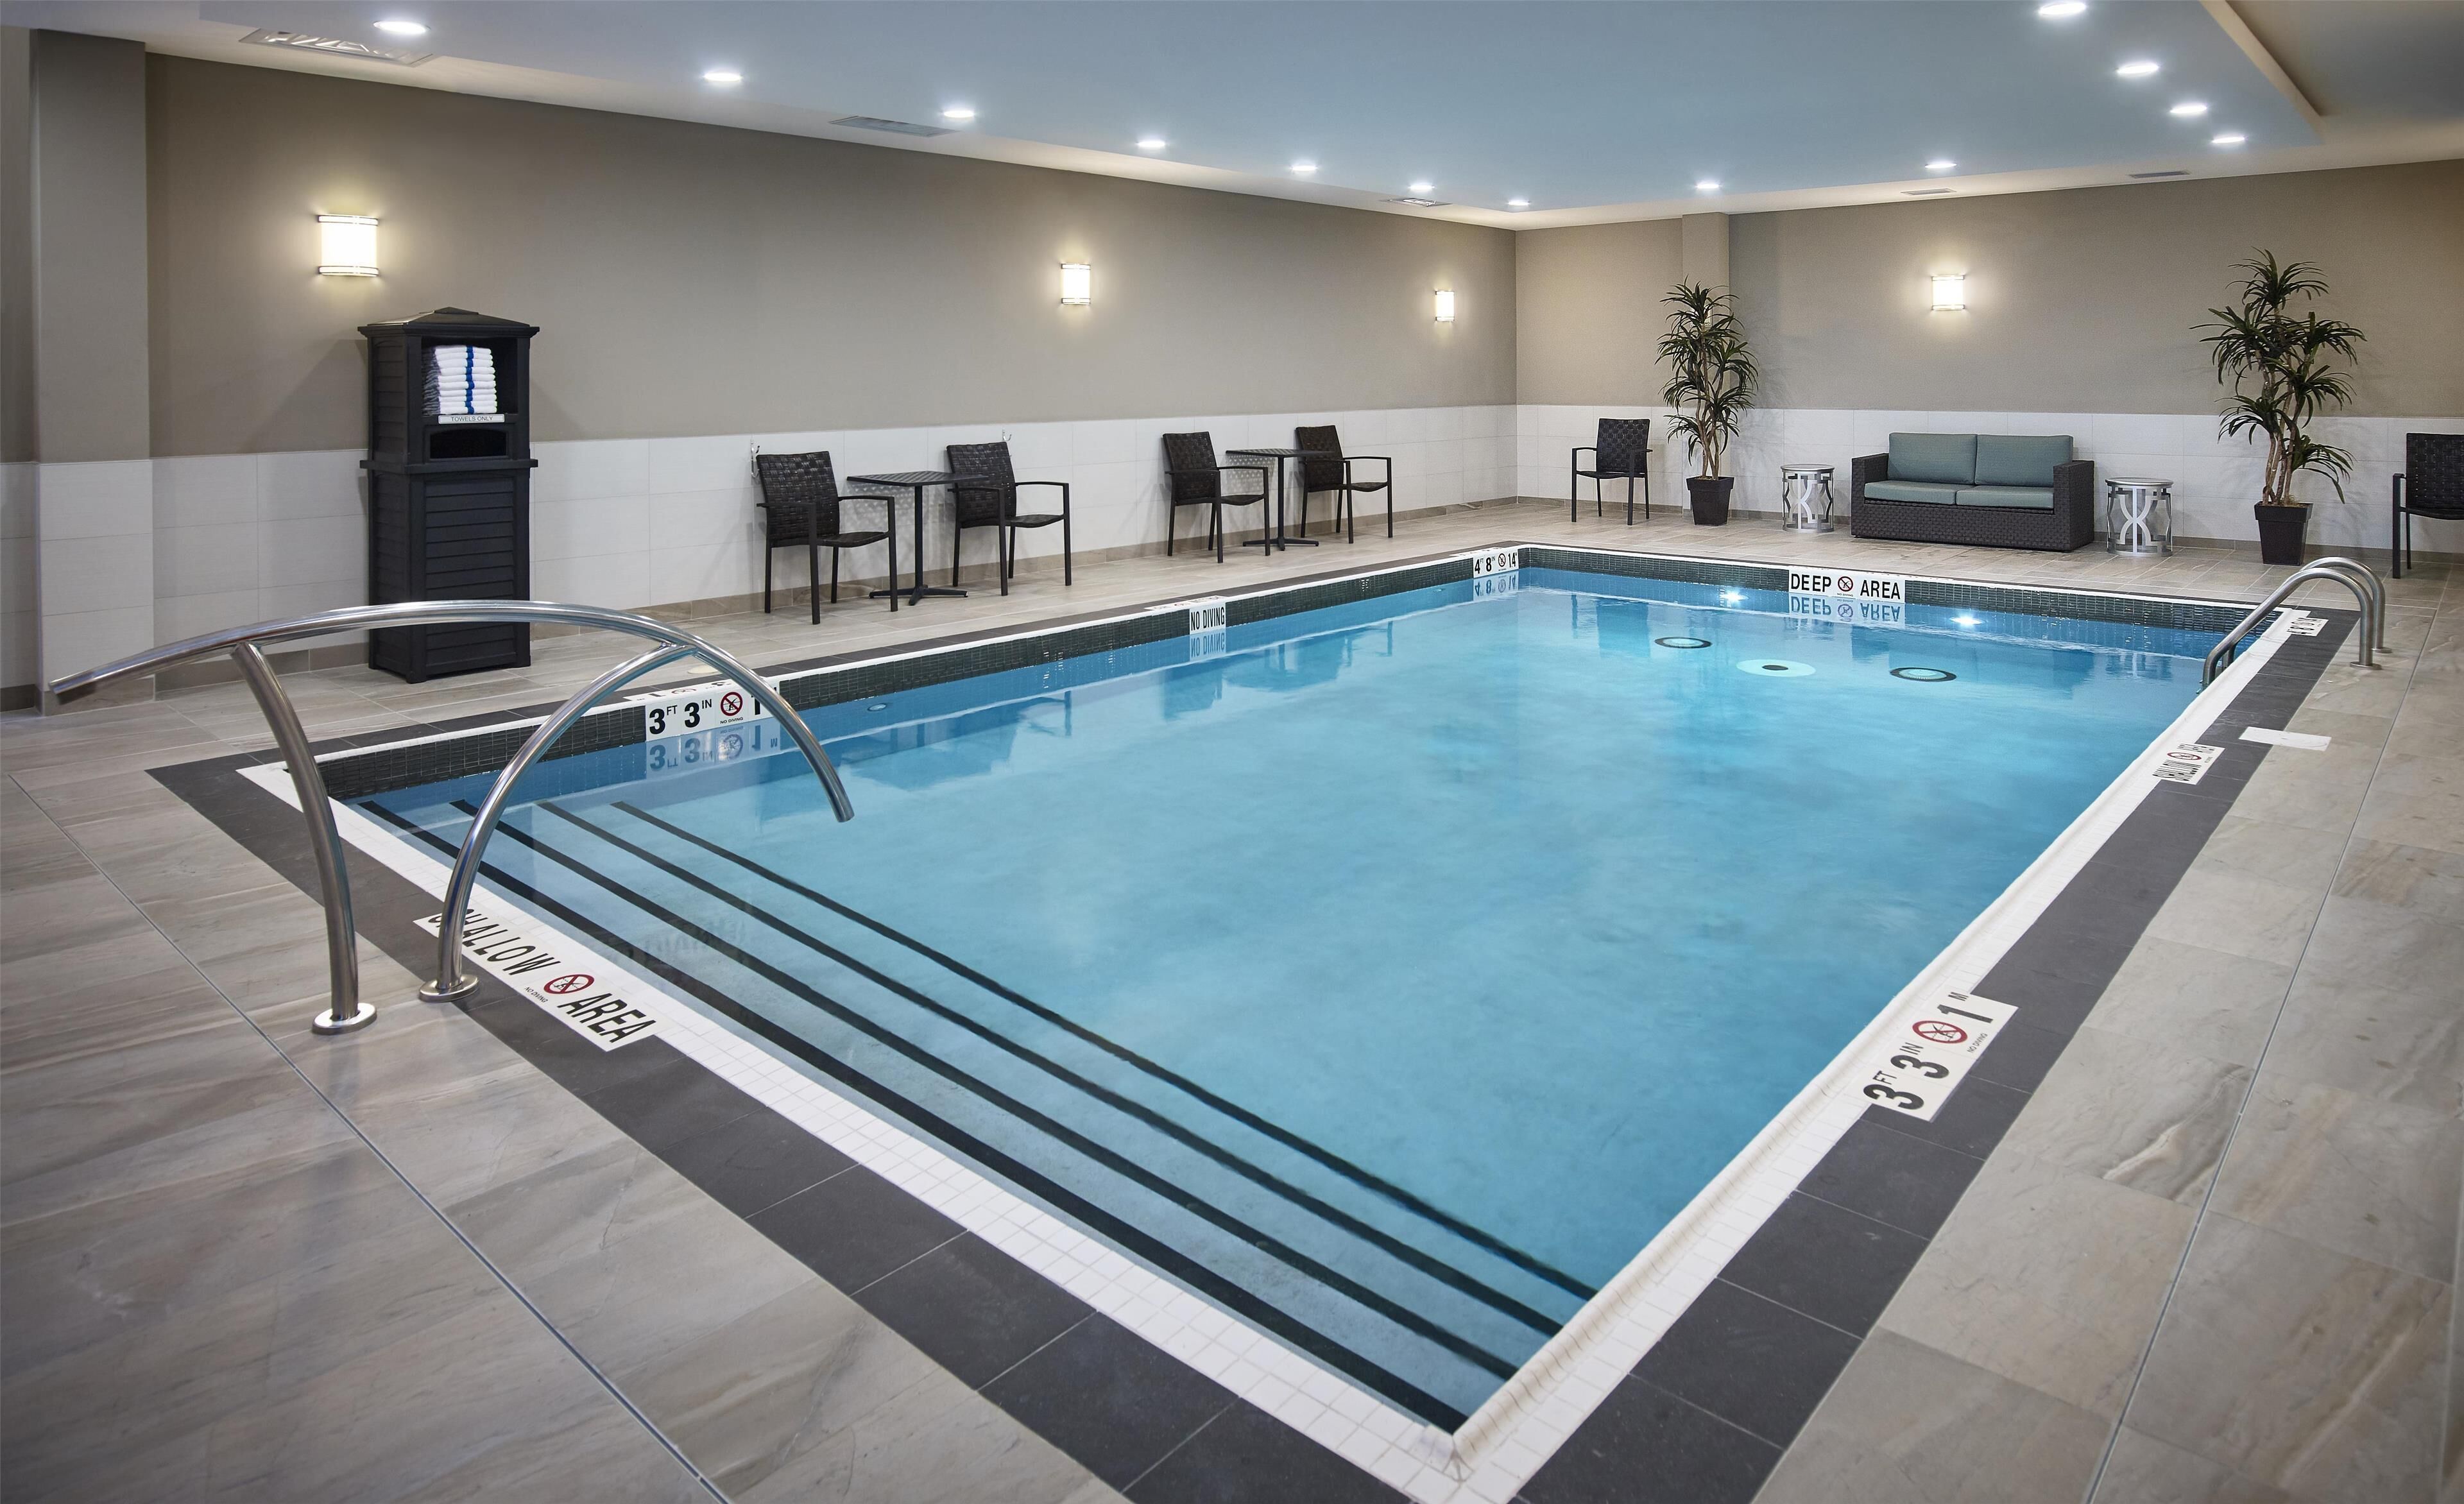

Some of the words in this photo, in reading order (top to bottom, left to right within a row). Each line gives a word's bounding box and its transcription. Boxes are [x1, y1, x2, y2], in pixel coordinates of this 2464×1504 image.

[1475, 559, 1480, 574] 4
[1486, 557, 1492, 572] 8
[1791, 573, 1831, 592] DEEP
[1860, 579, 1901, 600] AREA
[1191, 611, 1200, 631] NO
[1203, 606, 1225, 628] DIVING
[649, 708, 665, 735] 3
[667, 705, 678, 715] FT
[684, 702, 701, 728] 3
[701, 699, 712, 709] IN
[2152, 759, 2202, 782] SHALLOW
[531, 991, 549, 1003] DIVING
[1947, 991, 1969, 1002] M
[557, 993, 656, 1043] AREA
[1937, 1004, 1994, 1024] 1
[1899, 1042, 1924, 1055] IN
[1967, 1045, 1977, 1054] NO
[1972, 1032, 1988, 1047] DIVING
[1872, 1070, 1897, 1085] FT
[1890, 1054, 1949, 1079] 3
[1863, 1084, 1924, 1110] 3
